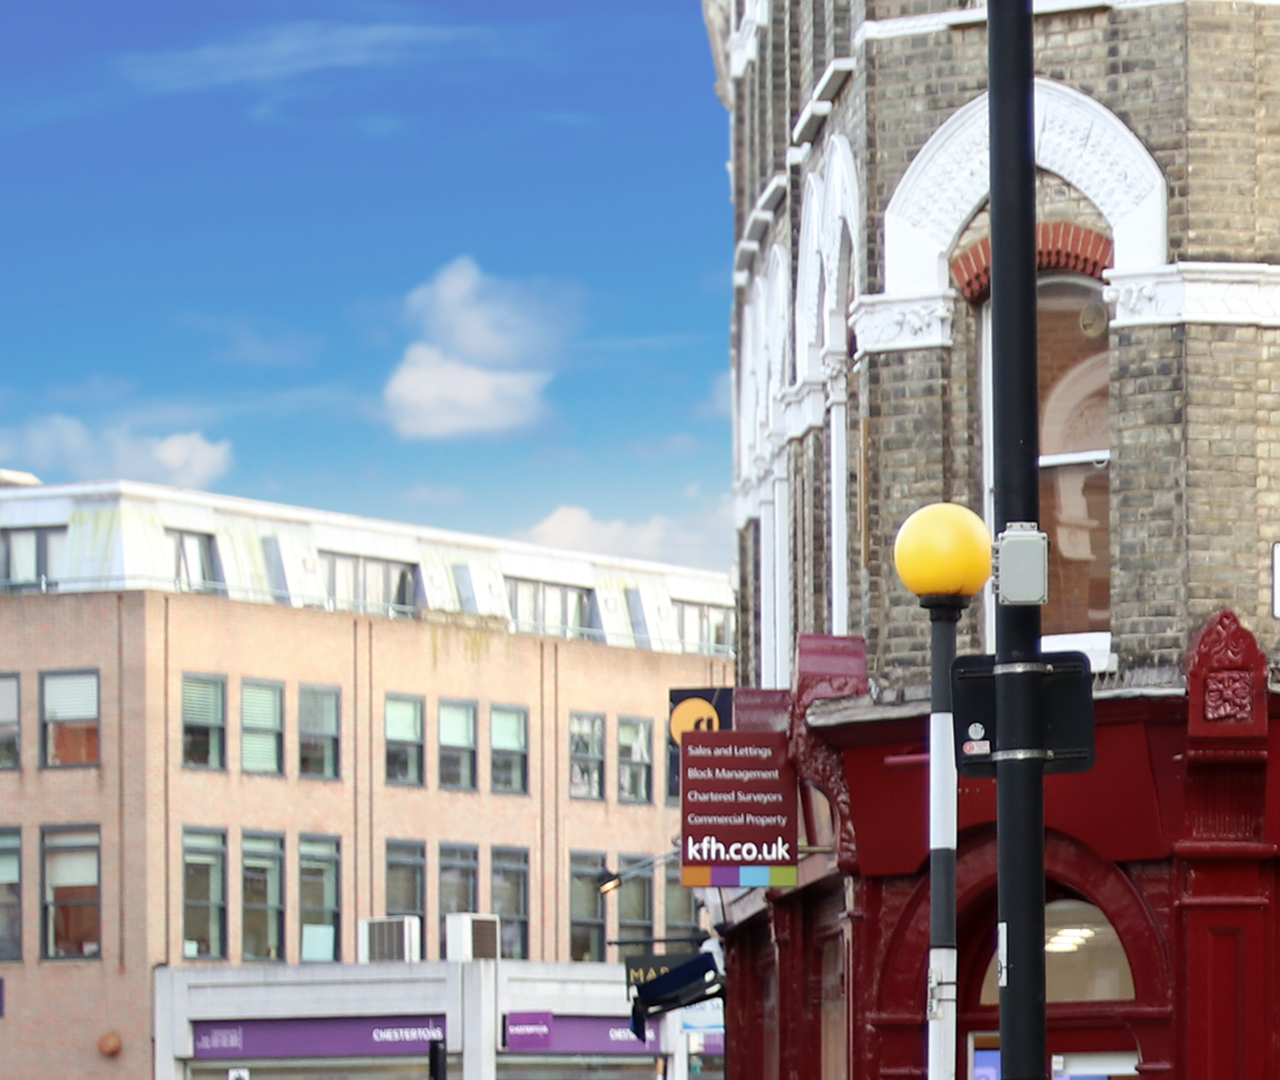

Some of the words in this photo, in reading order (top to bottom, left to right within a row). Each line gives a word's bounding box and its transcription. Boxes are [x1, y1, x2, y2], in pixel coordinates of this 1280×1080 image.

[687, 745, 711, 756] Sales
[711, 746, 731, 756] and
[733, 745, 772, 758] Lettings
[687, 767, 714, 779] Block
[715, 768, 780, 782] Management
[687, 790, 733, 802] Chartered
[736, 791, 783, 805] Surveyors
[687, 813, 744, 826] Commercial
[746, 813, 788, 828] Property
[687, 835, 791, 861] kfh.co.uk
